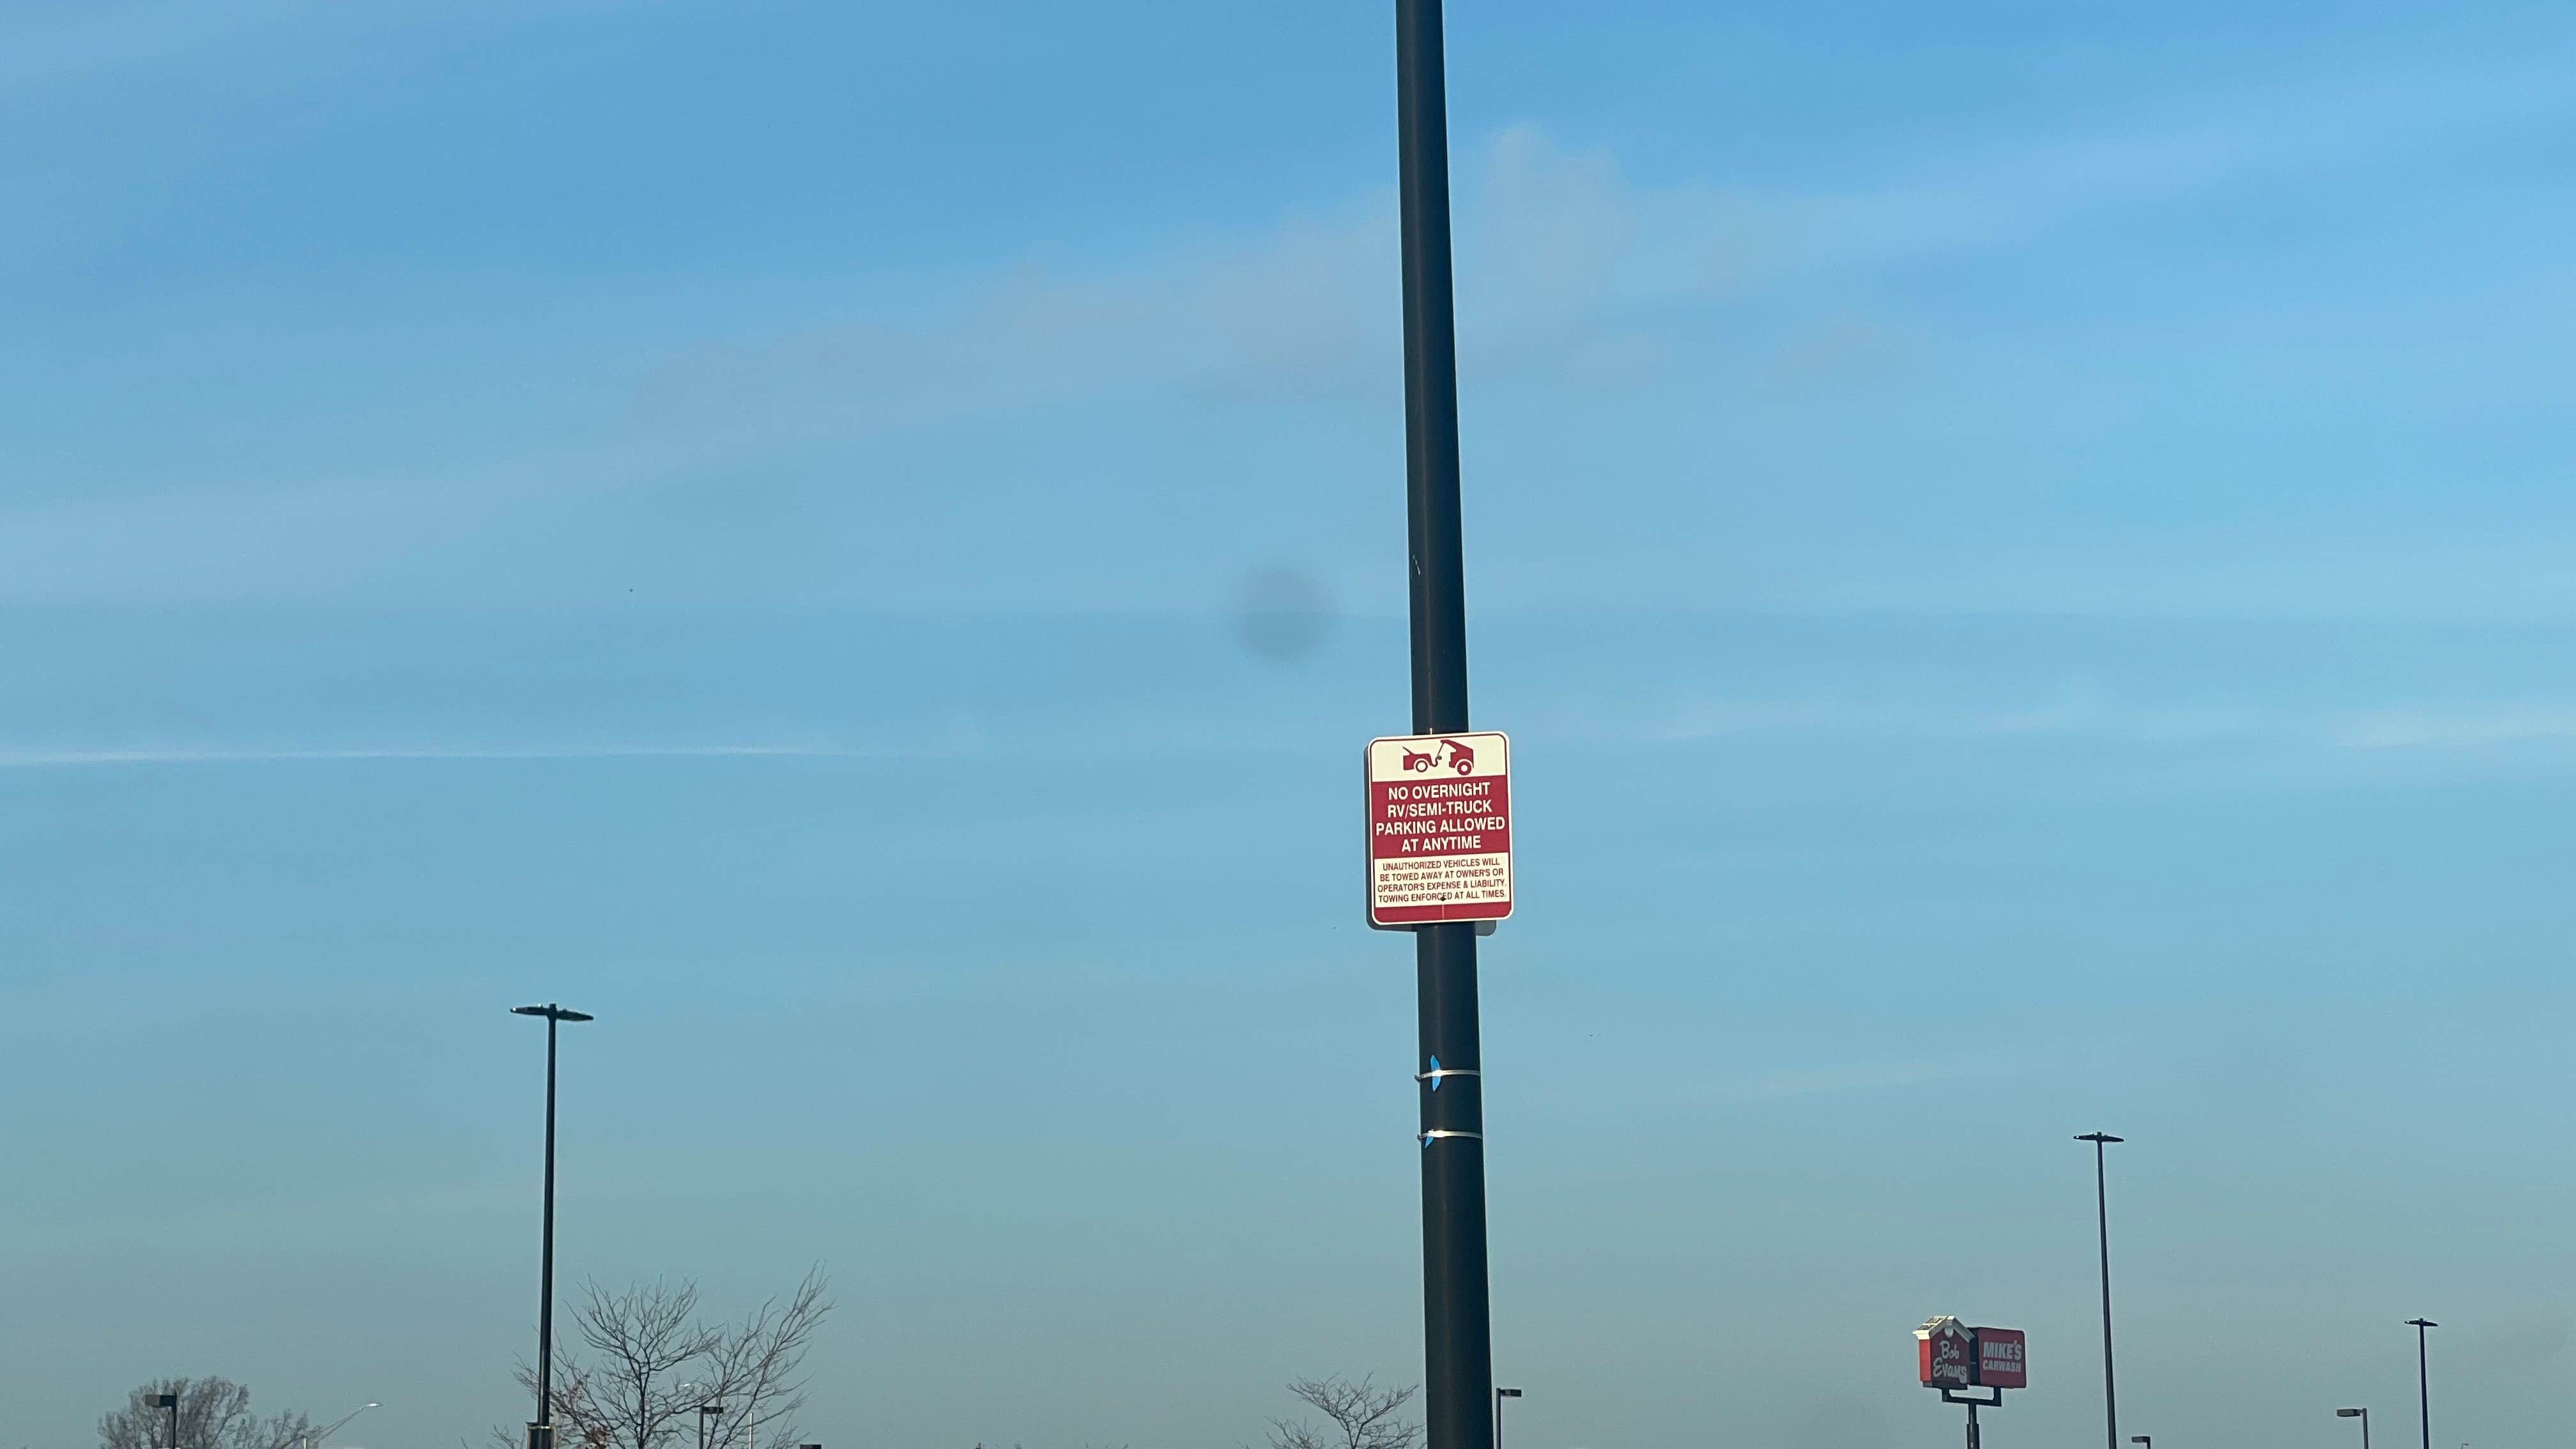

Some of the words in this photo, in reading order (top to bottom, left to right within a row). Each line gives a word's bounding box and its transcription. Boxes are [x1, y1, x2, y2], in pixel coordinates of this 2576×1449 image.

[1388, 786, 1408, 800] NO
[1412, 782, 1491, 799] OVERNIGHT
[1388, 799, 1492, 818] RV/SEMI-TRUCK
[1376, 820, 1436, 836] PARKING
[1439, 816, 1505, 832] ALLOWED
[1401, 839, 1419, 852] AT
[1422, 836, 1482, 851] ANYTIME
[1383, 861, 1441, 871] UNAUTHORIZED
[1443, 858, 1480, 868] VEHICLES
[1482, 857, 1500, 866] WILL
[1392, 873, 1419, 881] TOWED
[1421, 871, 1443, 880] AWAY
[1456, 870, 1490, 878] OWNER'S
[1377, 883, 1424, 892] OPERATOR'S
[1427, 881, 1460, 890] EXPENSE
[1379, 894, 1409, 903] TOWING
[1411, 892, 1452, 901] ENFORCED
[1455, 891, 1464, 900] AT
[1939, 1340, 1959, 1360] Bob
[1983, 1340, 2022, 1360] MIKE'S
[1933, 1356, 1967, 1383] Evans
[1983, 1360, 2021, 1372] CARWASH
